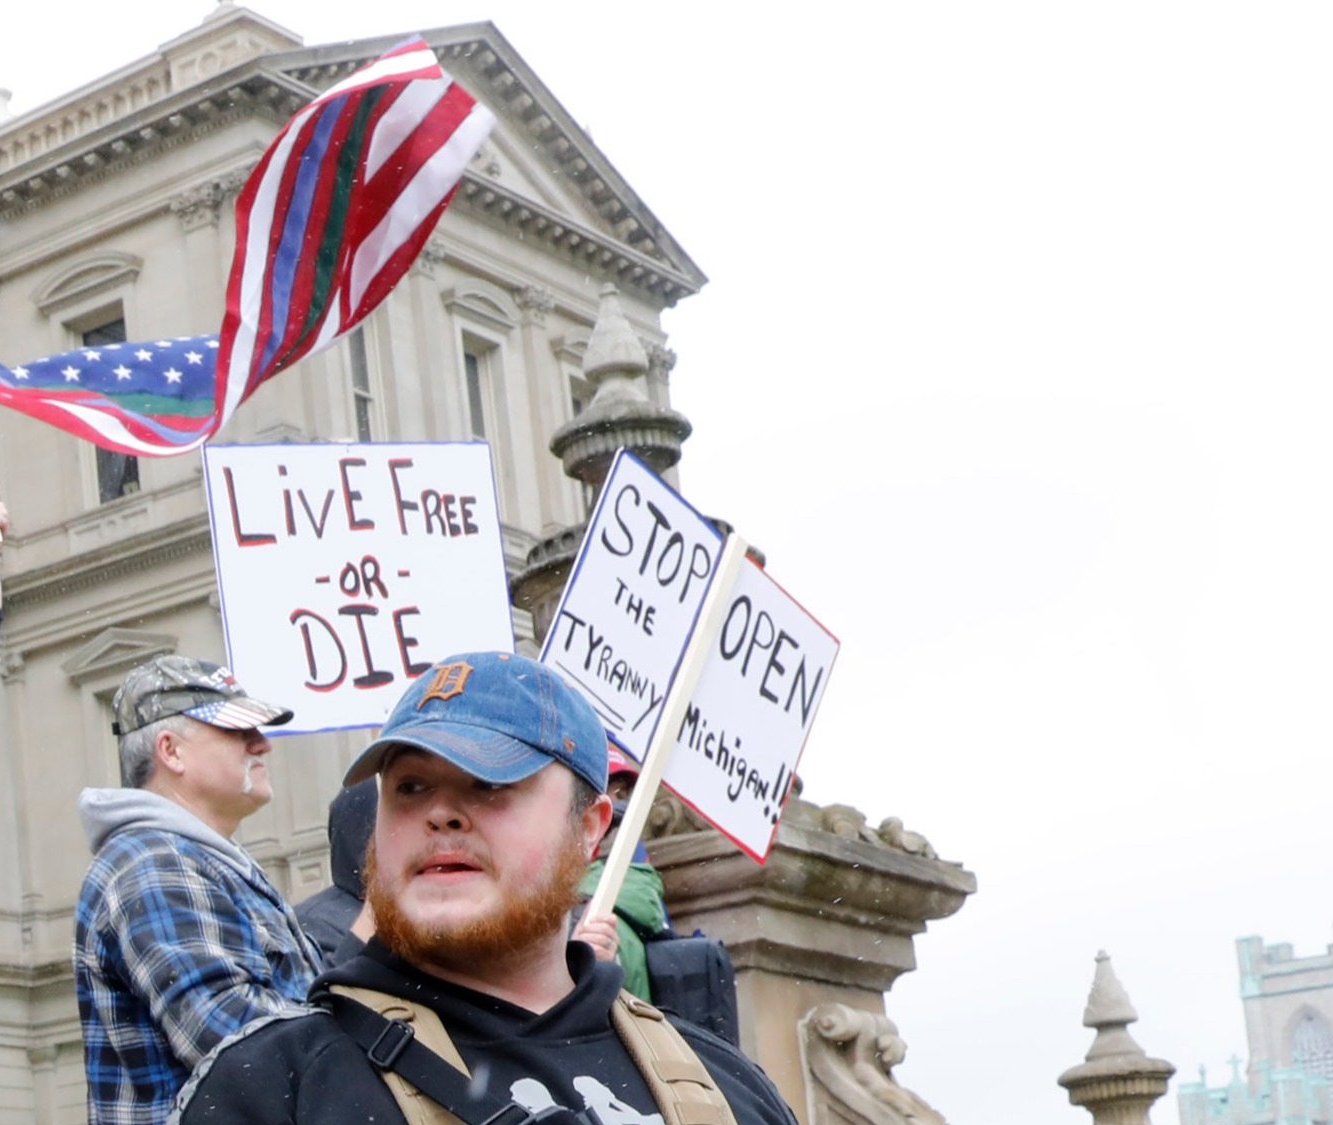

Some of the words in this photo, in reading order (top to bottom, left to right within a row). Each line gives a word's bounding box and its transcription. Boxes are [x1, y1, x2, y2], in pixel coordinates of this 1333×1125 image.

[601, 484, 711, 604] STOP
[289, 603, 433, 692] DIE
[613, 577, 656, 637] THE
[719, 594, 824, 729] OPEN
[562, 610, 664, 732] TYRANNY
